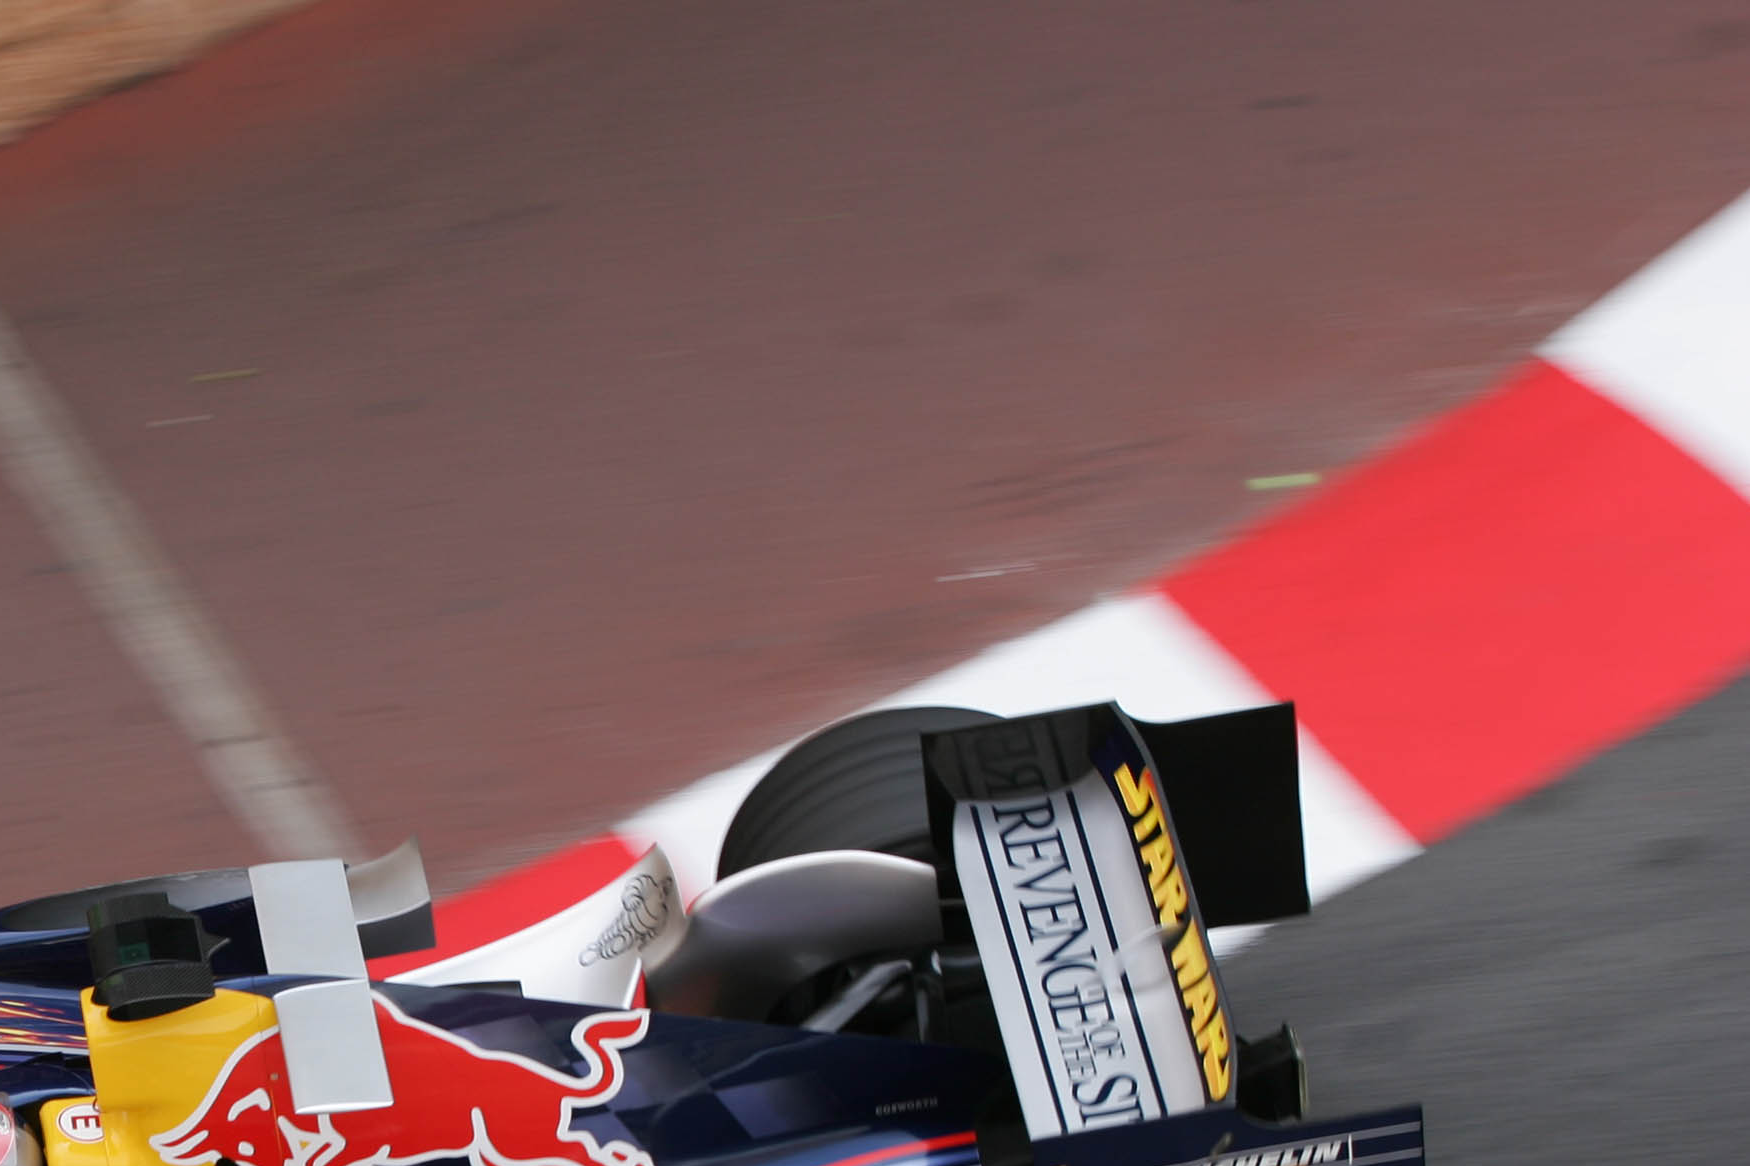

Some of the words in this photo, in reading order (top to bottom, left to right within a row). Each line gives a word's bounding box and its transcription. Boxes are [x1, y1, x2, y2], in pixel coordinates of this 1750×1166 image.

[993, 797, 1115, 1030] REVENGE
[1072, 1074, 1144, 1129] SI
[1113, 762, 1188, 925] STAR
